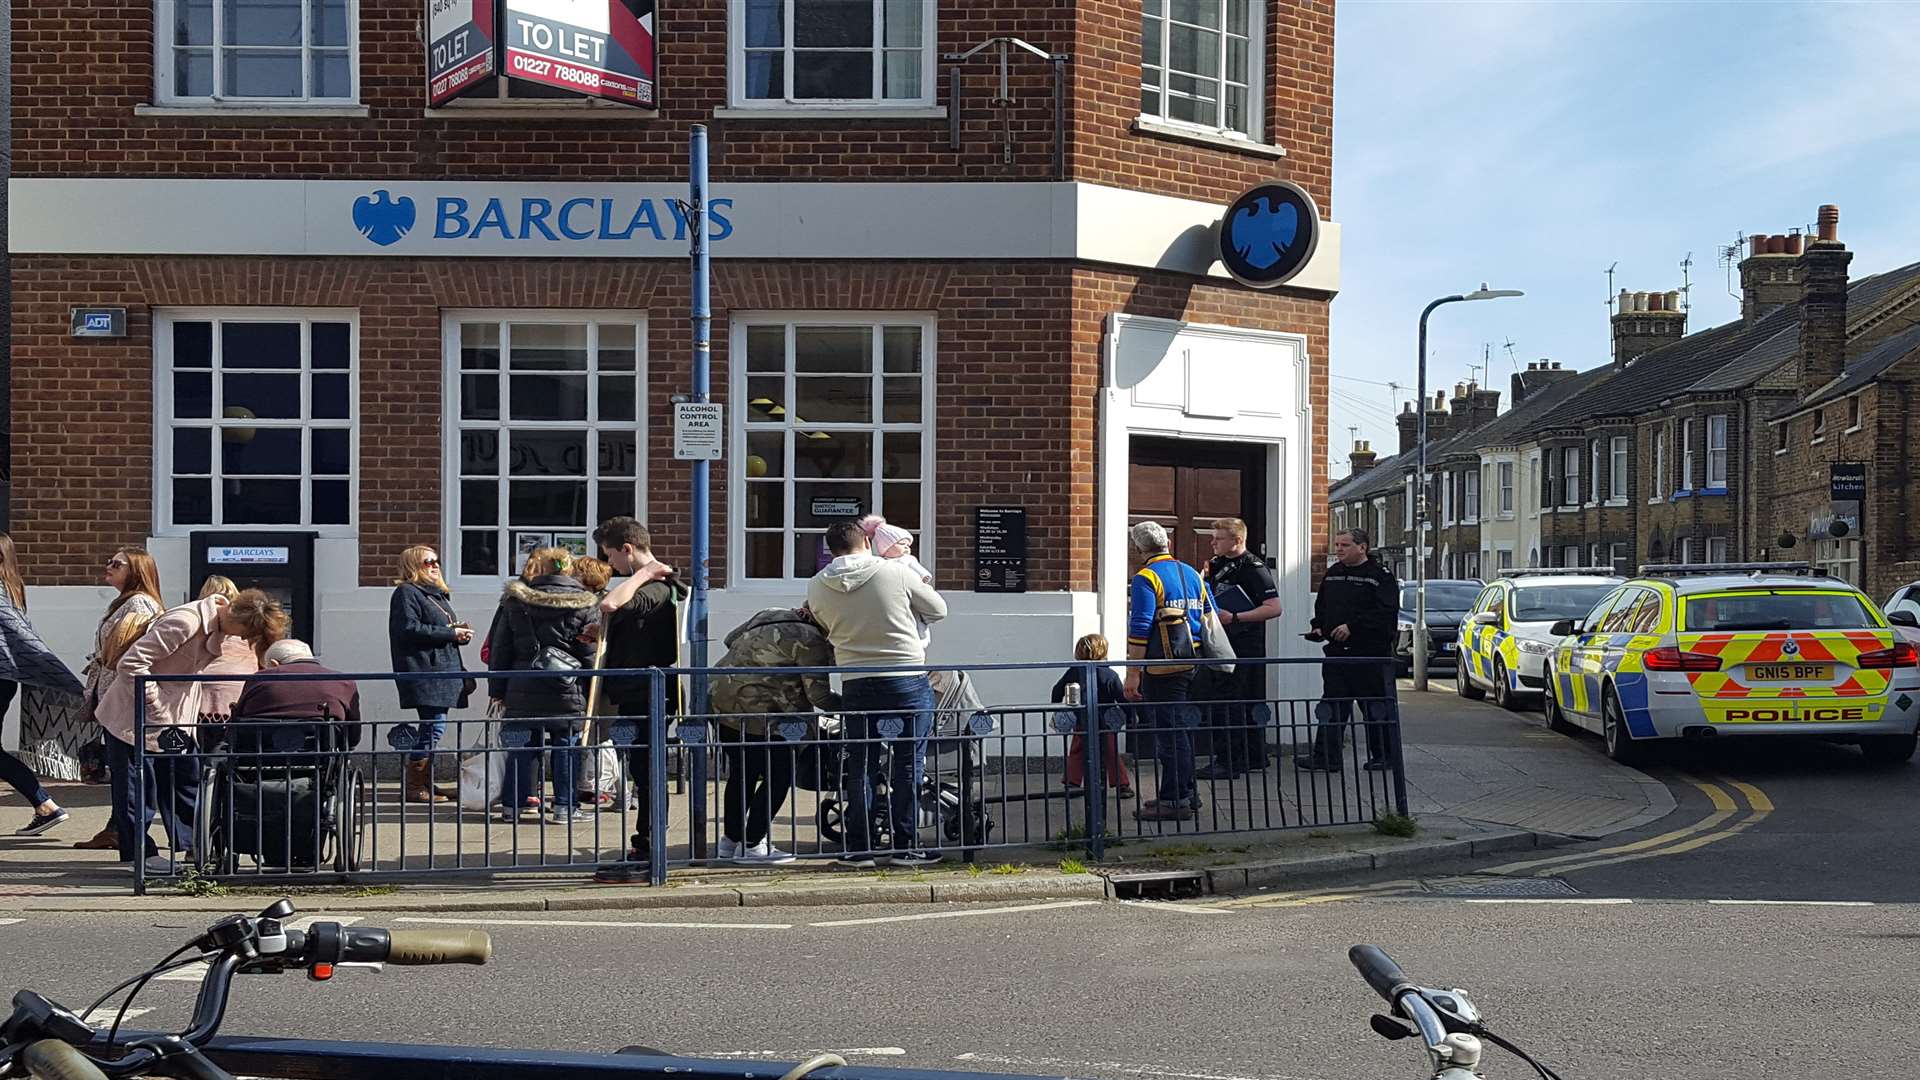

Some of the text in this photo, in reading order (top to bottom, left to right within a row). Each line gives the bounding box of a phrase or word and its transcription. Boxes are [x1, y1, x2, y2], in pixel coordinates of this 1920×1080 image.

[433, 44, 446, 72] TO
[448, 30, 469, 63] LET
[517, 19, 605, 62] TO LET
[513, 56, 600, 87] 01227 788088
[433, 197, 733, 241] BARCLAYS
[87, 317, 109, 328] ADT
[1755, 666, 1824, 679] GN15 BPF
[1726, 709, 1863, 721] POLICE
